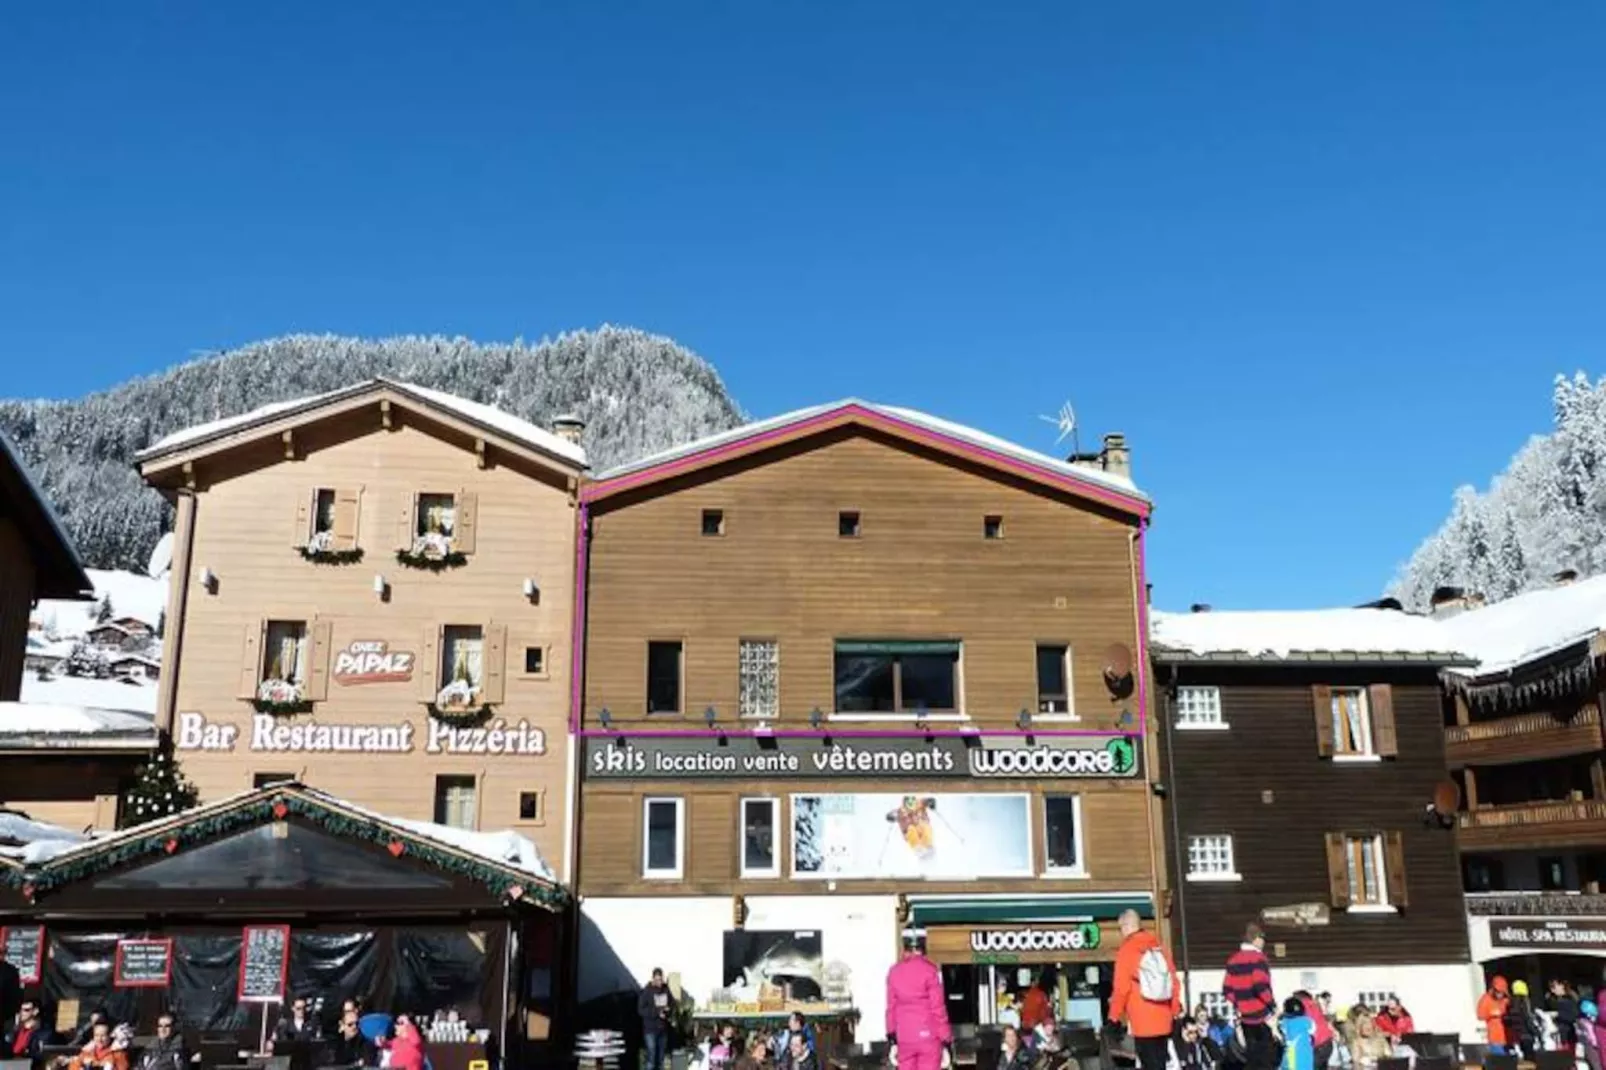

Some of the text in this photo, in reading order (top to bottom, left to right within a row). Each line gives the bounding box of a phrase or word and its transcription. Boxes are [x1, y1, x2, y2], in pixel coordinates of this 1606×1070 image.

[334, 651, 411, 674] PAPAZ
[178, 712, 546, 755] Bar Restaurant Pizzéria
[593, 744, 954, 772] skis location vente vêtements
